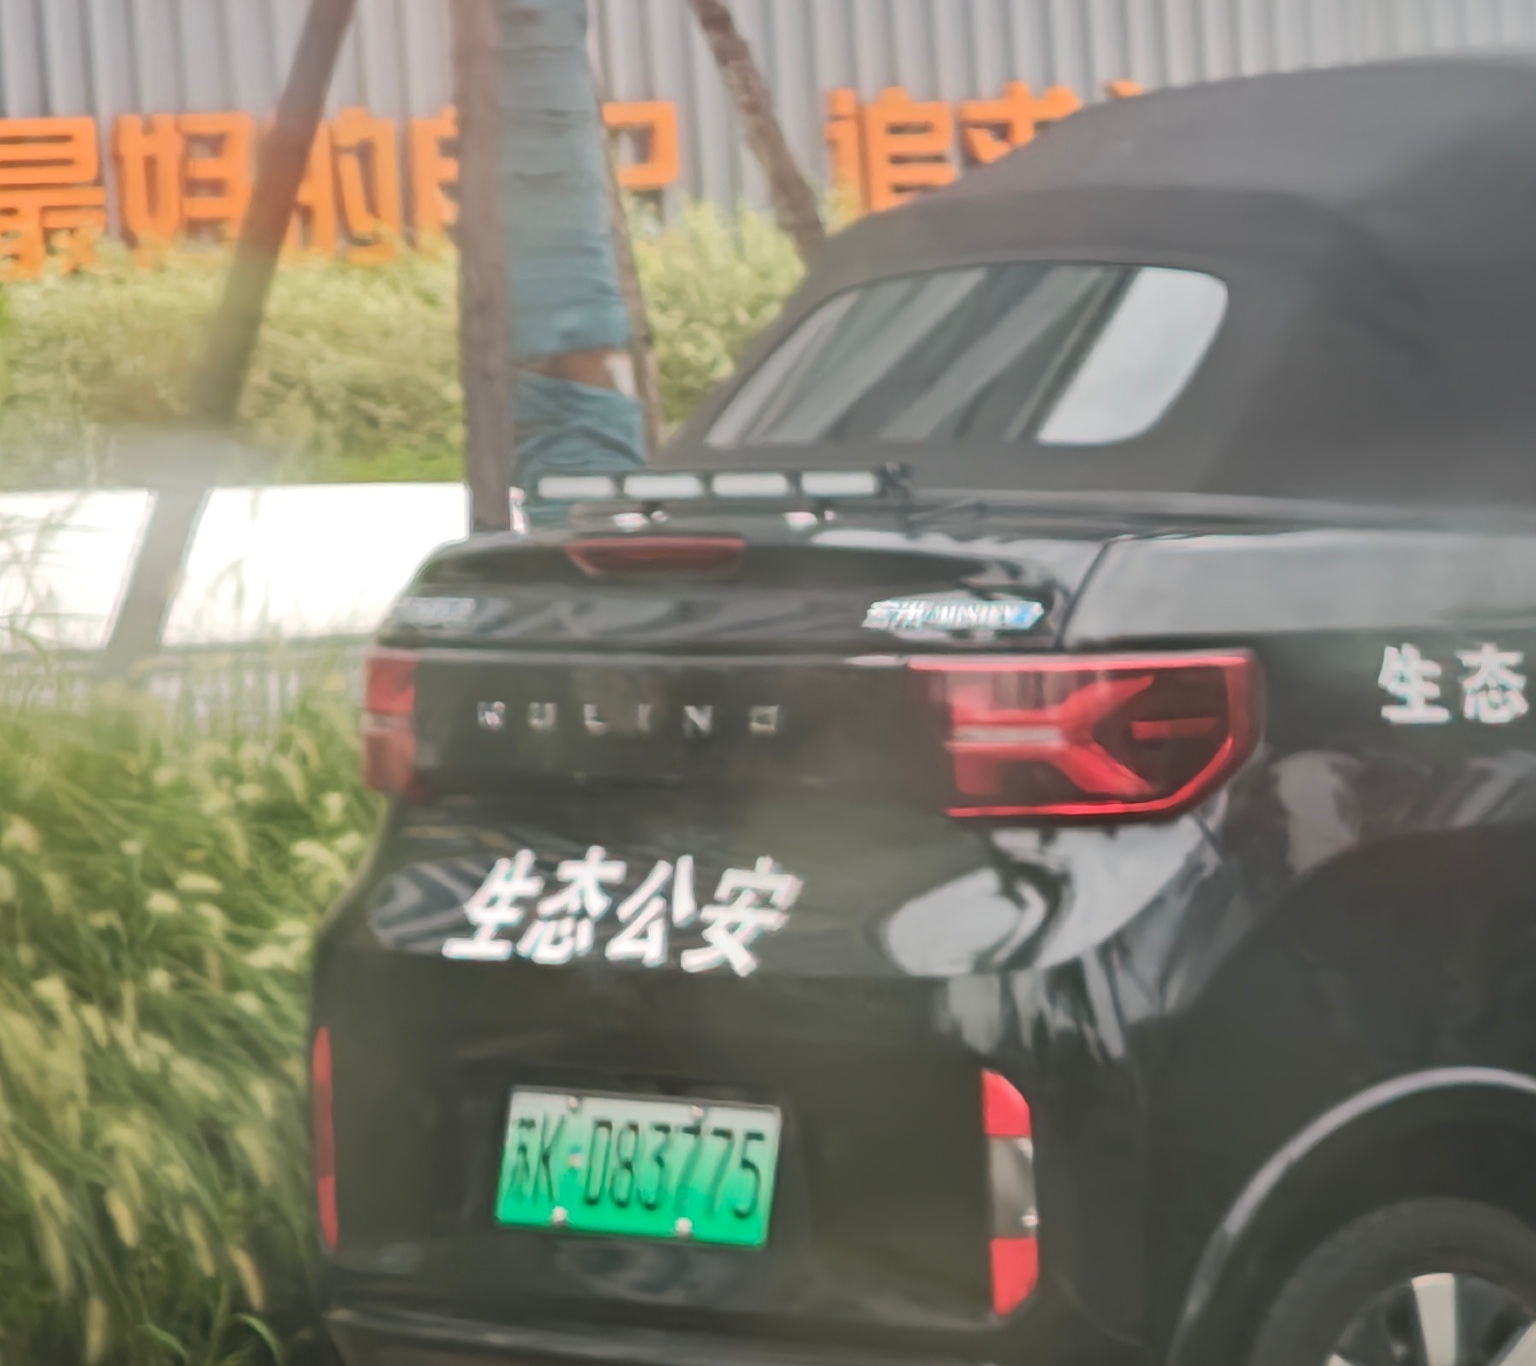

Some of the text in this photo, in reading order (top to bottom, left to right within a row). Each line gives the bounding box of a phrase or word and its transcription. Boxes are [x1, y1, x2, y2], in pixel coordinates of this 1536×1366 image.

[1378, 642, 1530, 725] 生态
[442, 845, 803, 977] 生态公安
